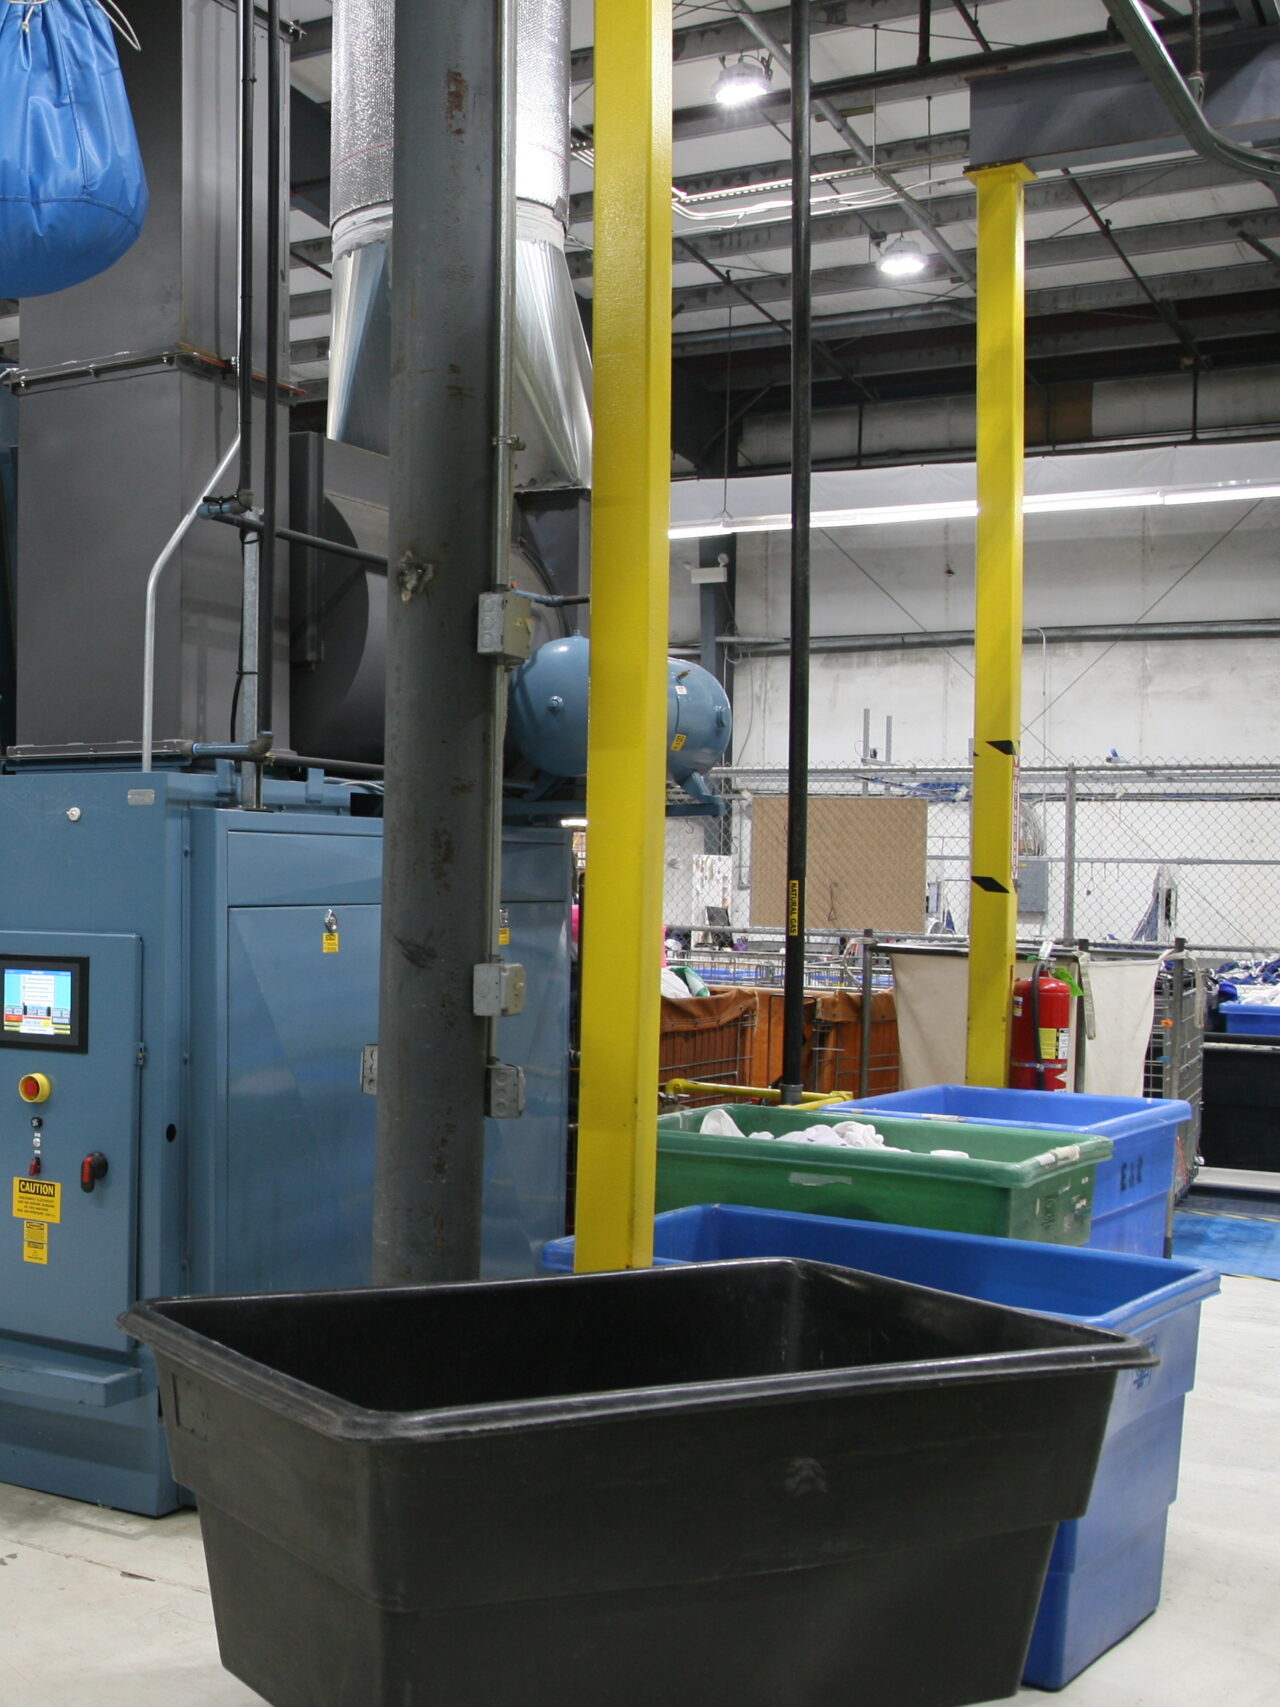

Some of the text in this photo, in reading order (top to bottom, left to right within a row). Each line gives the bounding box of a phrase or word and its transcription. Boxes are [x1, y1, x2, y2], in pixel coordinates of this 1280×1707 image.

[790, 882, 798, 934] NATURAL GAS
[19, 1181, 54, 1196] CAUTION
